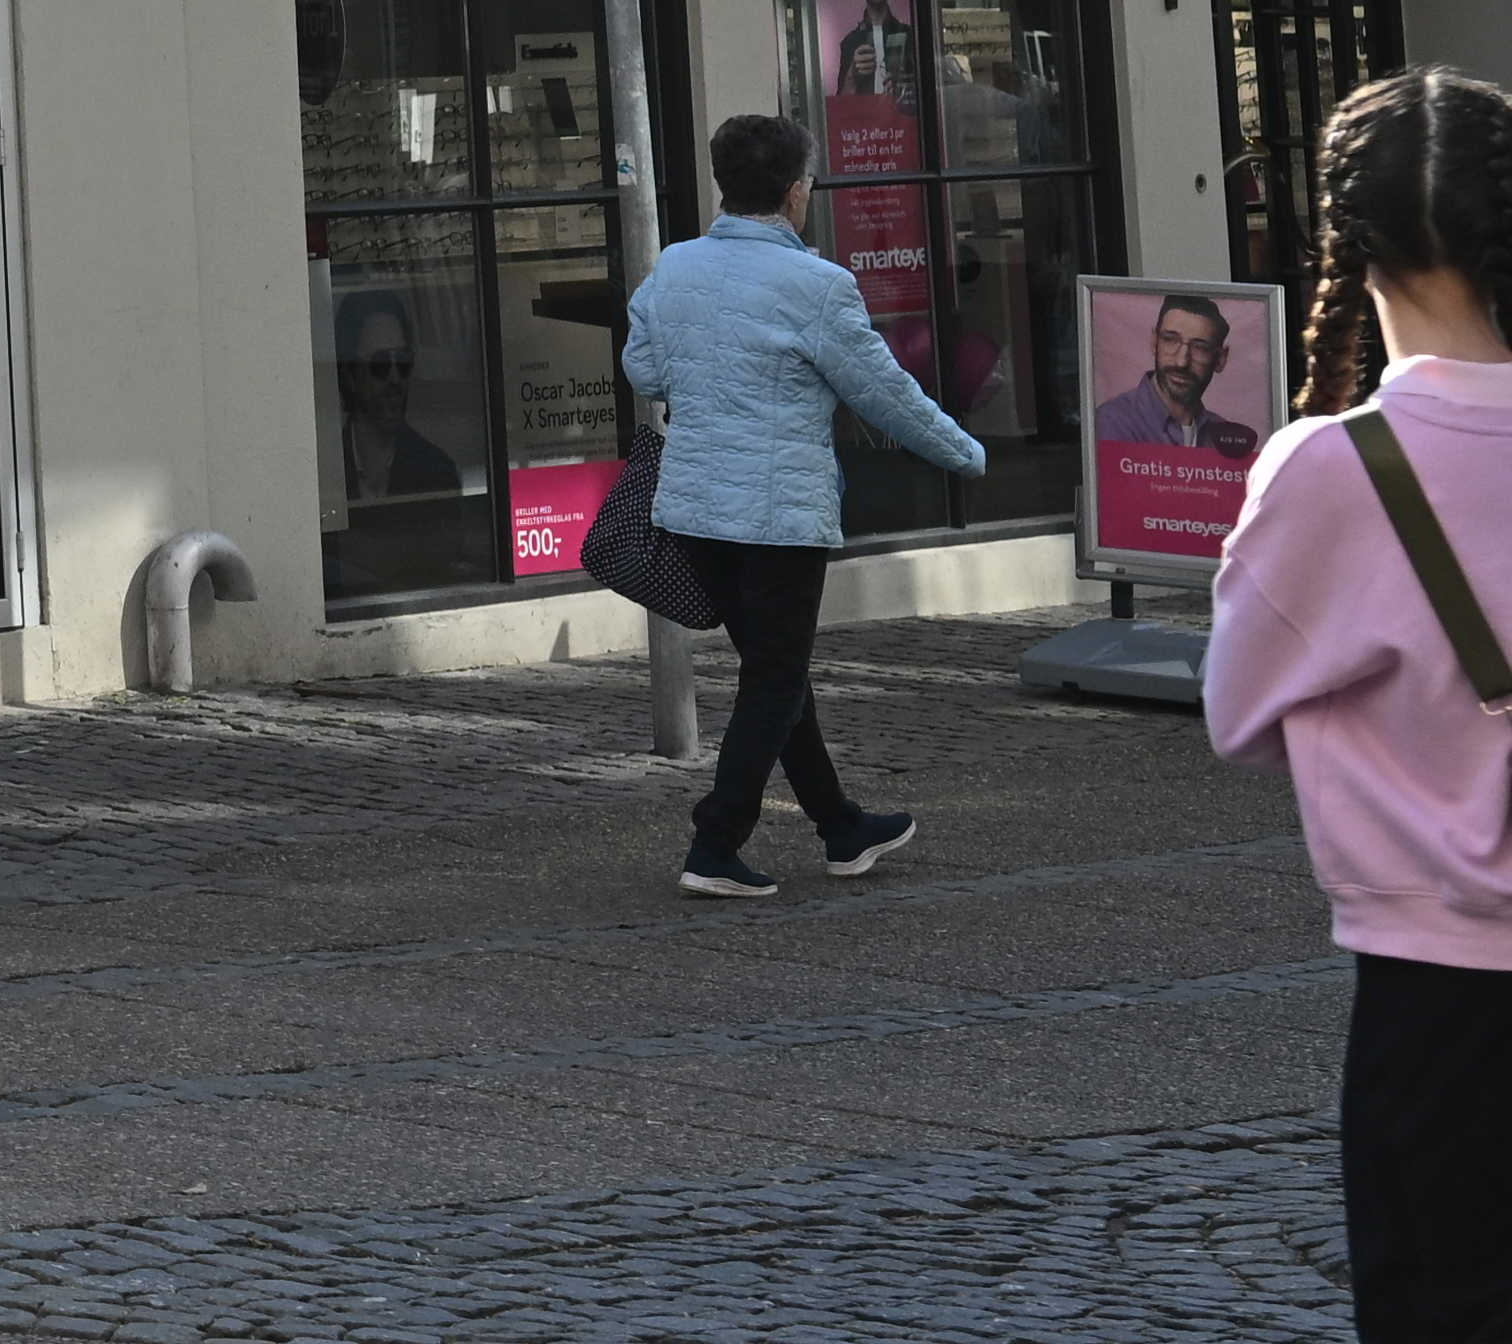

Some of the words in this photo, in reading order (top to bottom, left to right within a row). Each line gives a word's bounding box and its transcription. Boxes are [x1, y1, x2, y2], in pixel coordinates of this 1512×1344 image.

[520, 381, 565, 403] Oscar
[523, 408, 534, 431] X
[539, 405, 615, 431] Smarteyes
[1119, 456, 1173, 478] Gratis
[1176, 463, 1250, 483] synstest
[1143, 515, 1233, 536] smarteyes
[517, 527, 562, 559] 500,-
